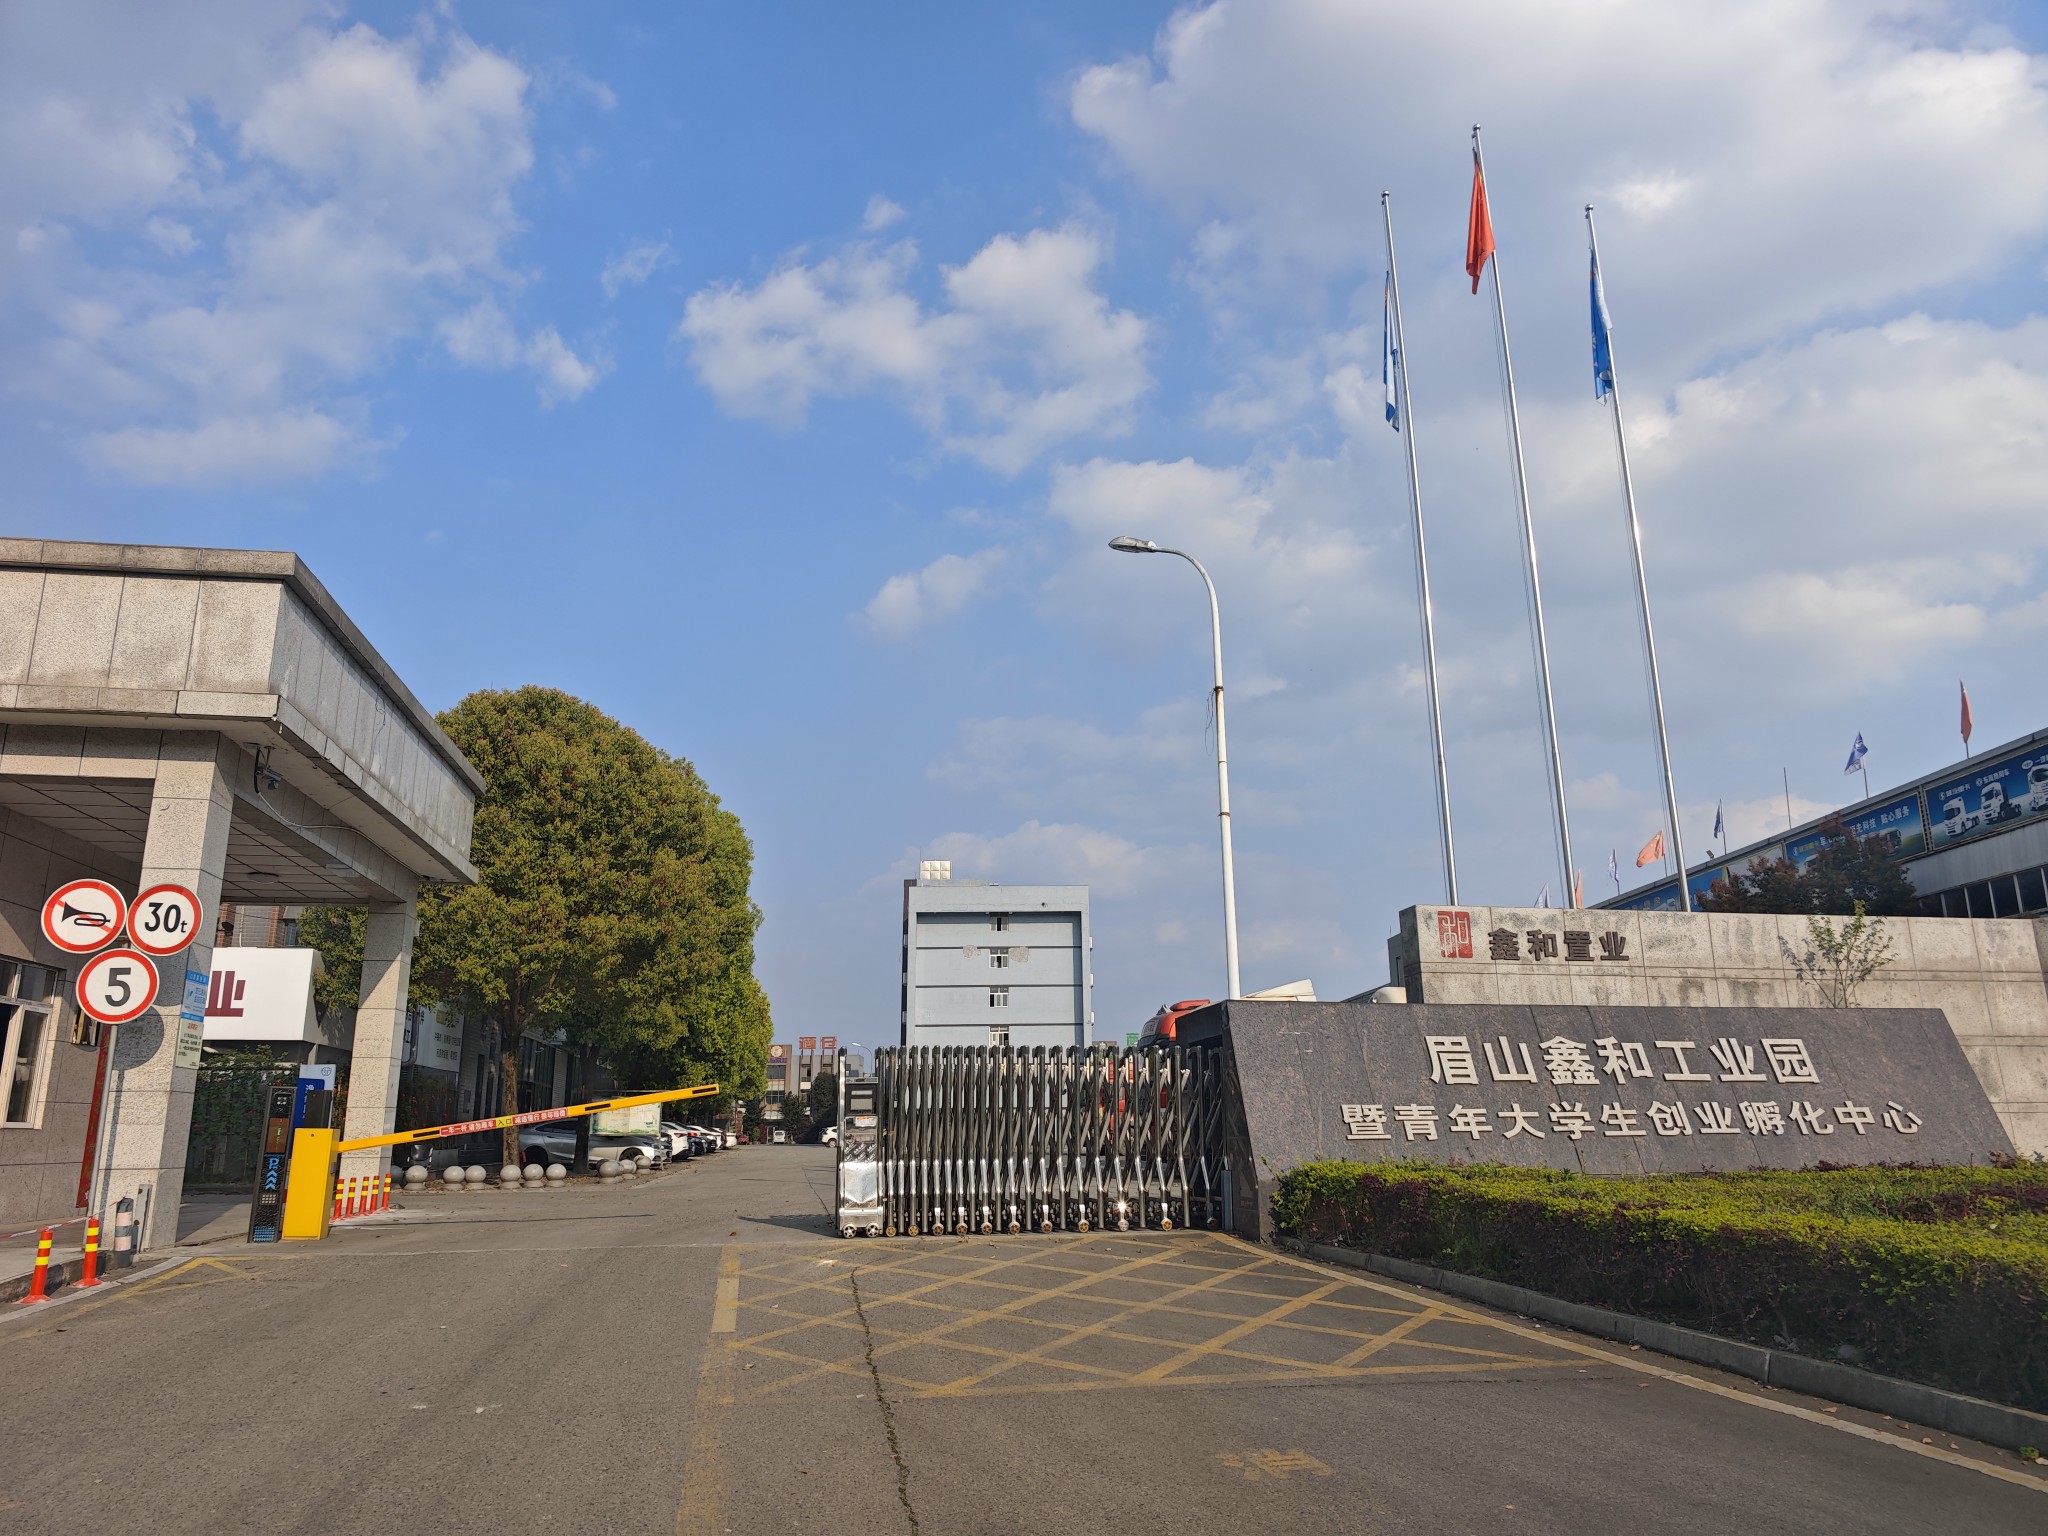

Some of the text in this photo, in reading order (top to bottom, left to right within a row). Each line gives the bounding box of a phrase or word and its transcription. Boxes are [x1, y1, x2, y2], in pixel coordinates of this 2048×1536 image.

[1488, 927, 1630, 962] 鑫和置业
[104, 967, 131, 1007] 5
[1424, 1034, 1820, 1087] 眉山鑫和工业园
[1341, 1099, 1923, 1142] 暨青年大学生创业孵化中心
